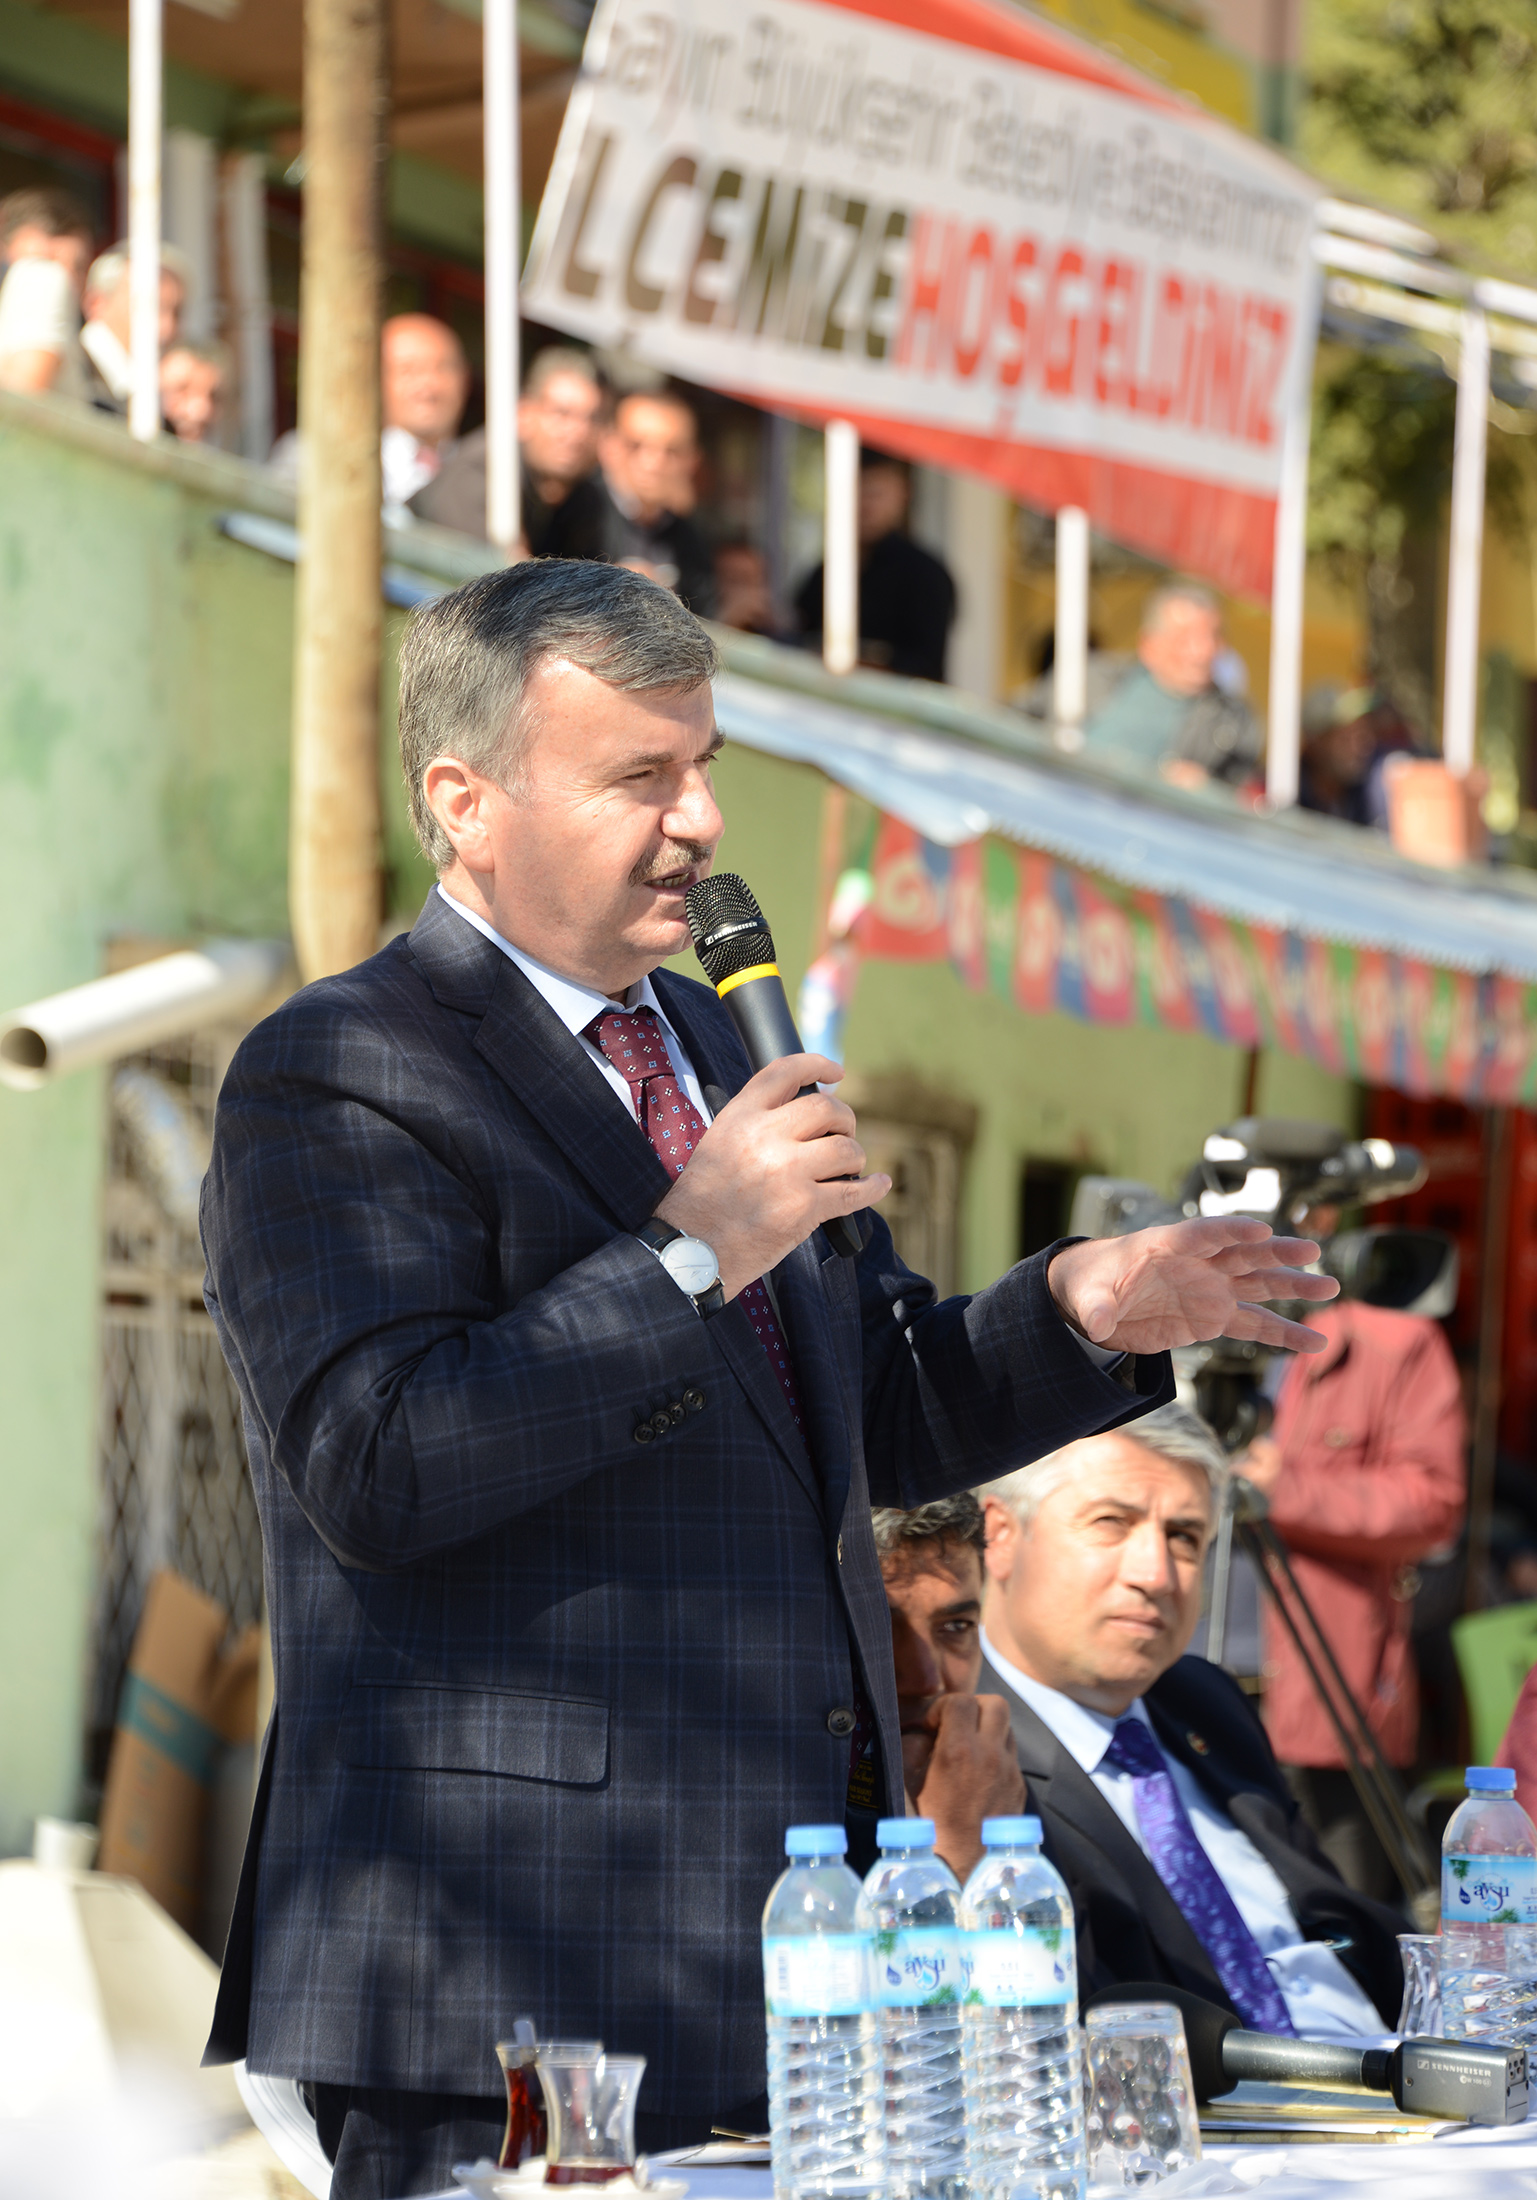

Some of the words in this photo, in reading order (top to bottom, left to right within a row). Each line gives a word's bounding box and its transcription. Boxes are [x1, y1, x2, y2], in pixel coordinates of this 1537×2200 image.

[713, 921, 758, 940] SENNHEISER
[1474, 1882, 1510, 1912] aysu
[904, 1956, 946, 1991] aysu
[1431, 2063, 1492, 2077] SENNHEISER
